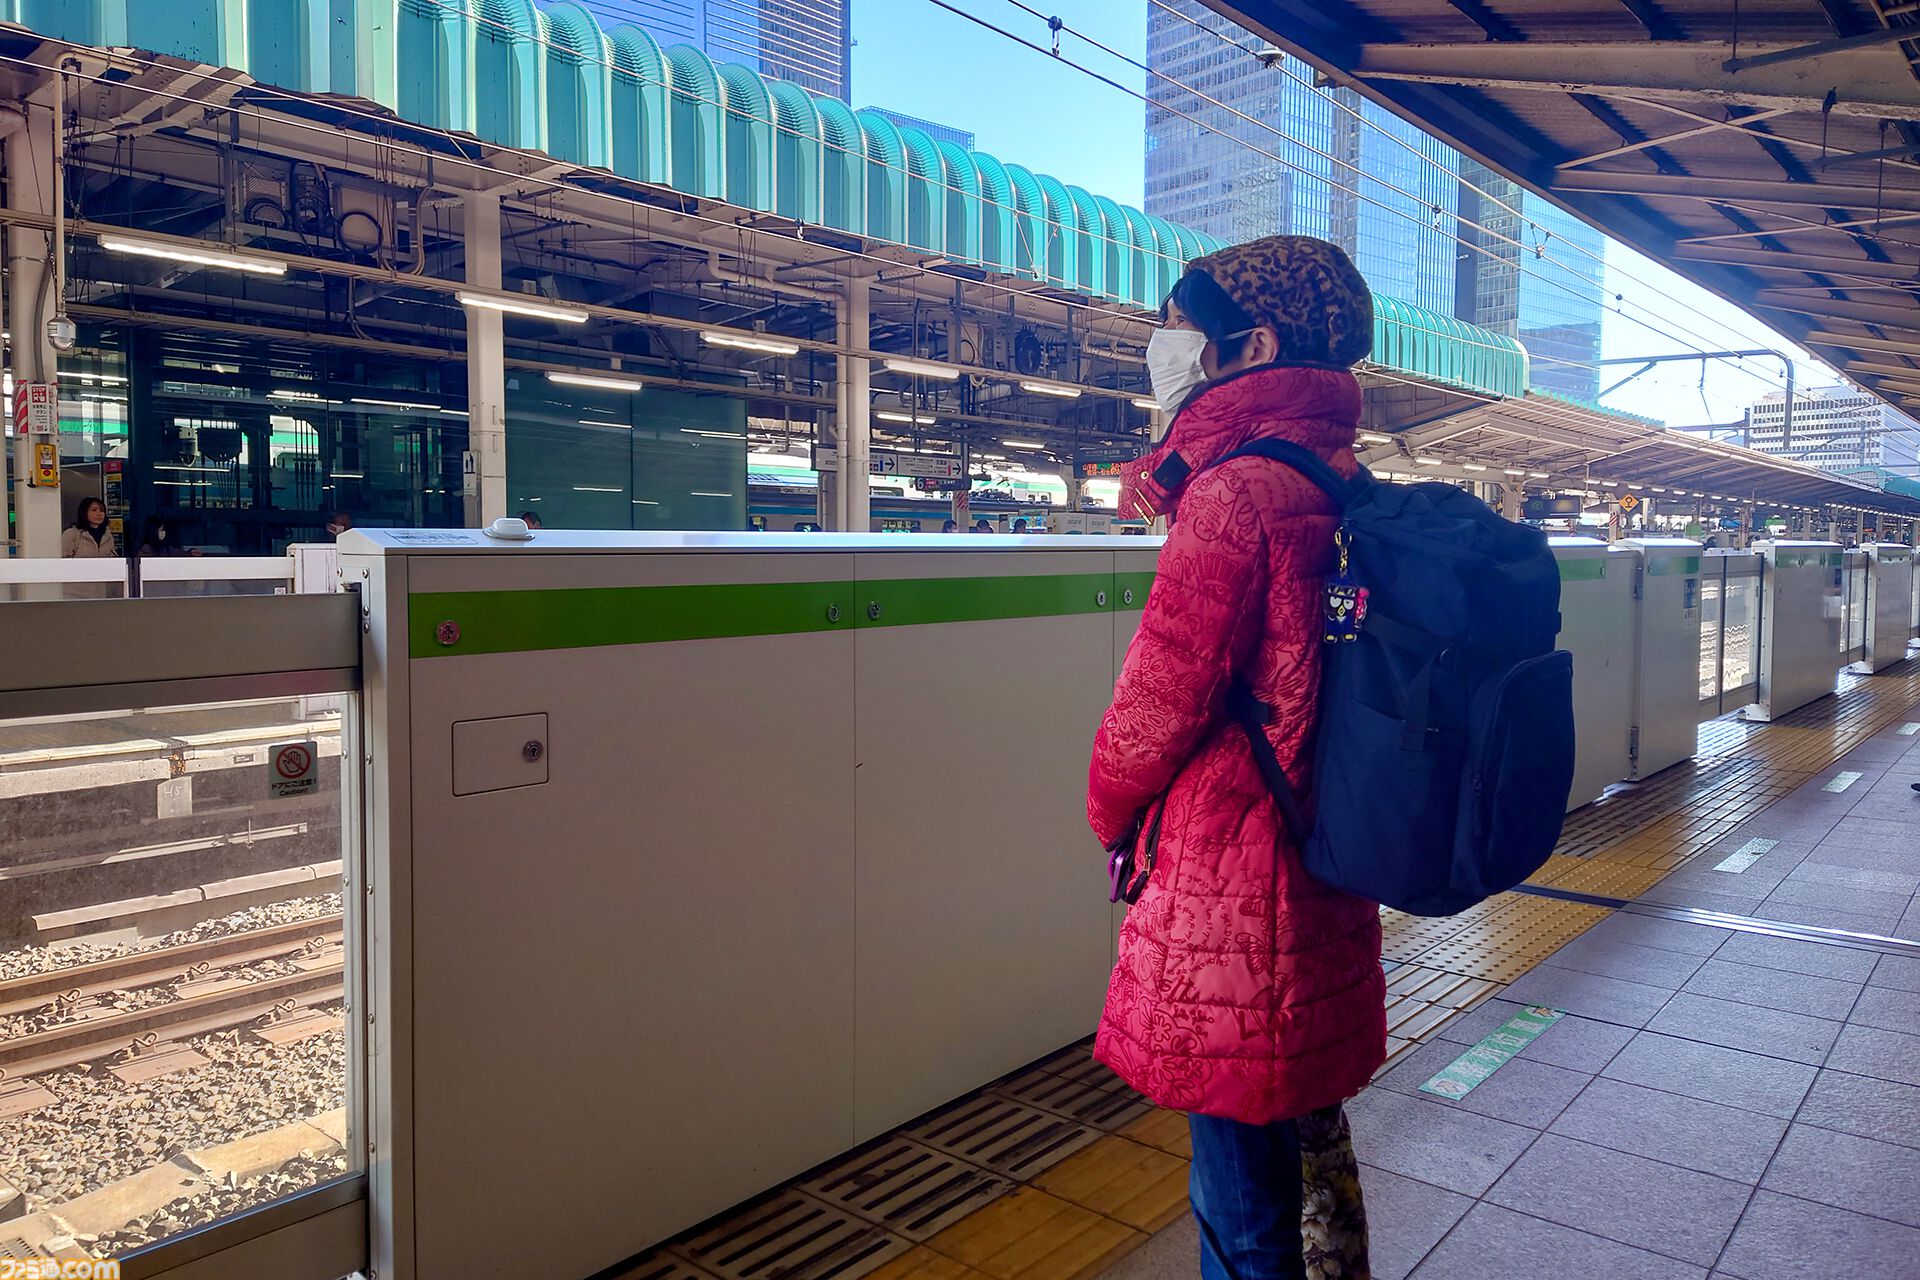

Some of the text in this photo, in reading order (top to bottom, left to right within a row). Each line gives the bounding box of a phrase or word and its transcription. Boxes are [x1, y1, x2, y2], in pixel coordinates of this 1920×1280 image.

[1132, 448, 1139, 458] 5
[917, 478, 924, 489] 6
[279, 787, 308, 797] Caution!
